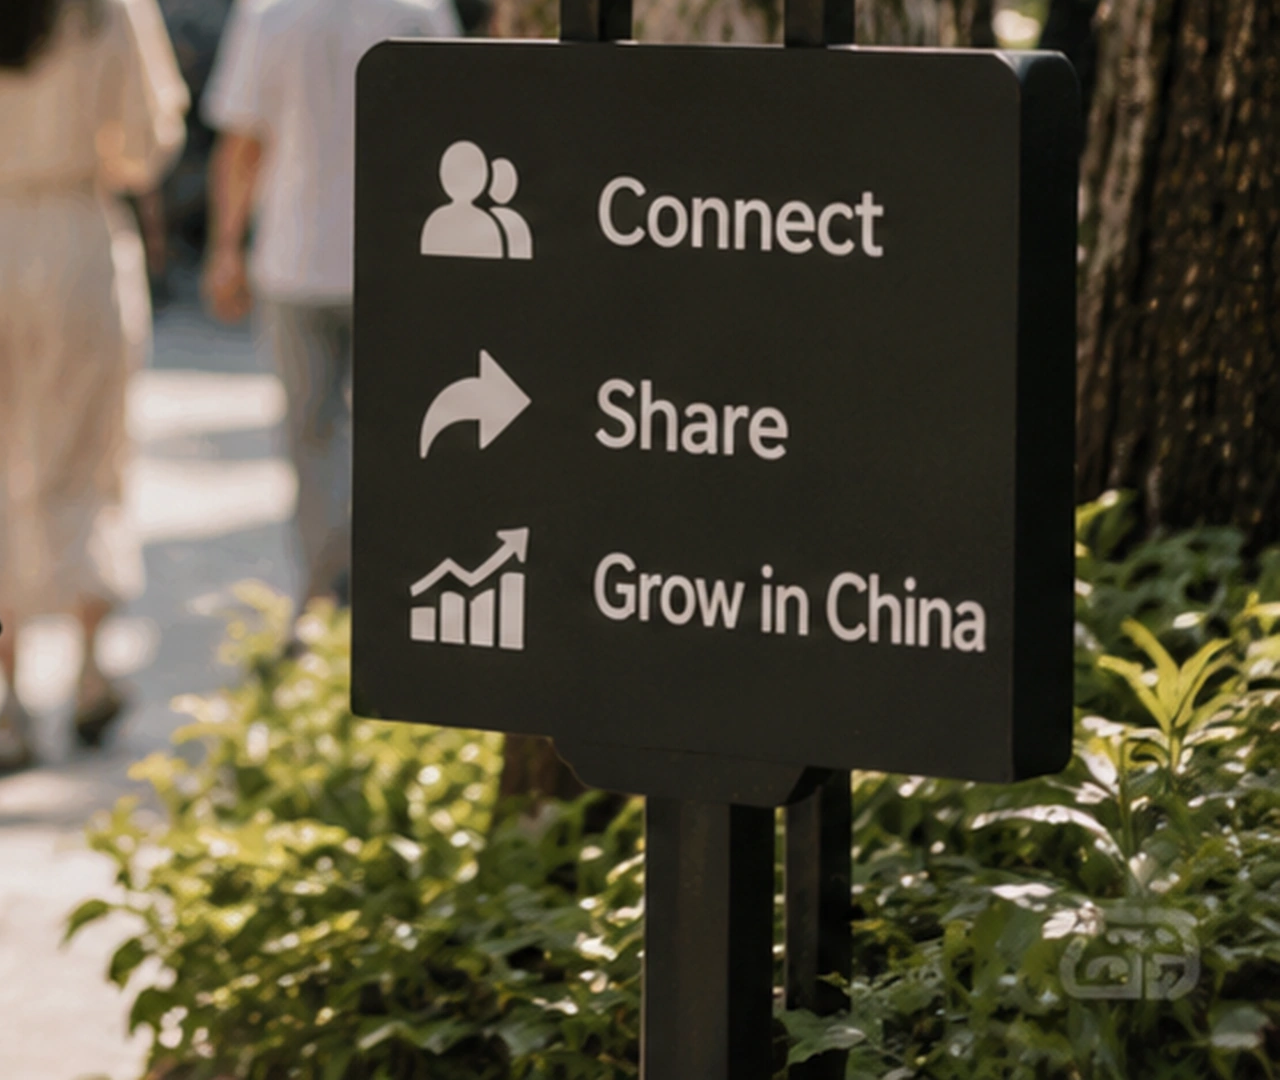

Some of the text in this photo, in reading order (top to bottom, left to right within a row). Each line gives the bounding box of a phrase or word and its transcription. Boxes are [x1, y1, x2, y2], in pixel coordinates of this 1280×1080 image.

[598, 176, 885, 258] Connect
[595, 378, 790, 461] Share
[594, 552, 987, 653] Grow in China
